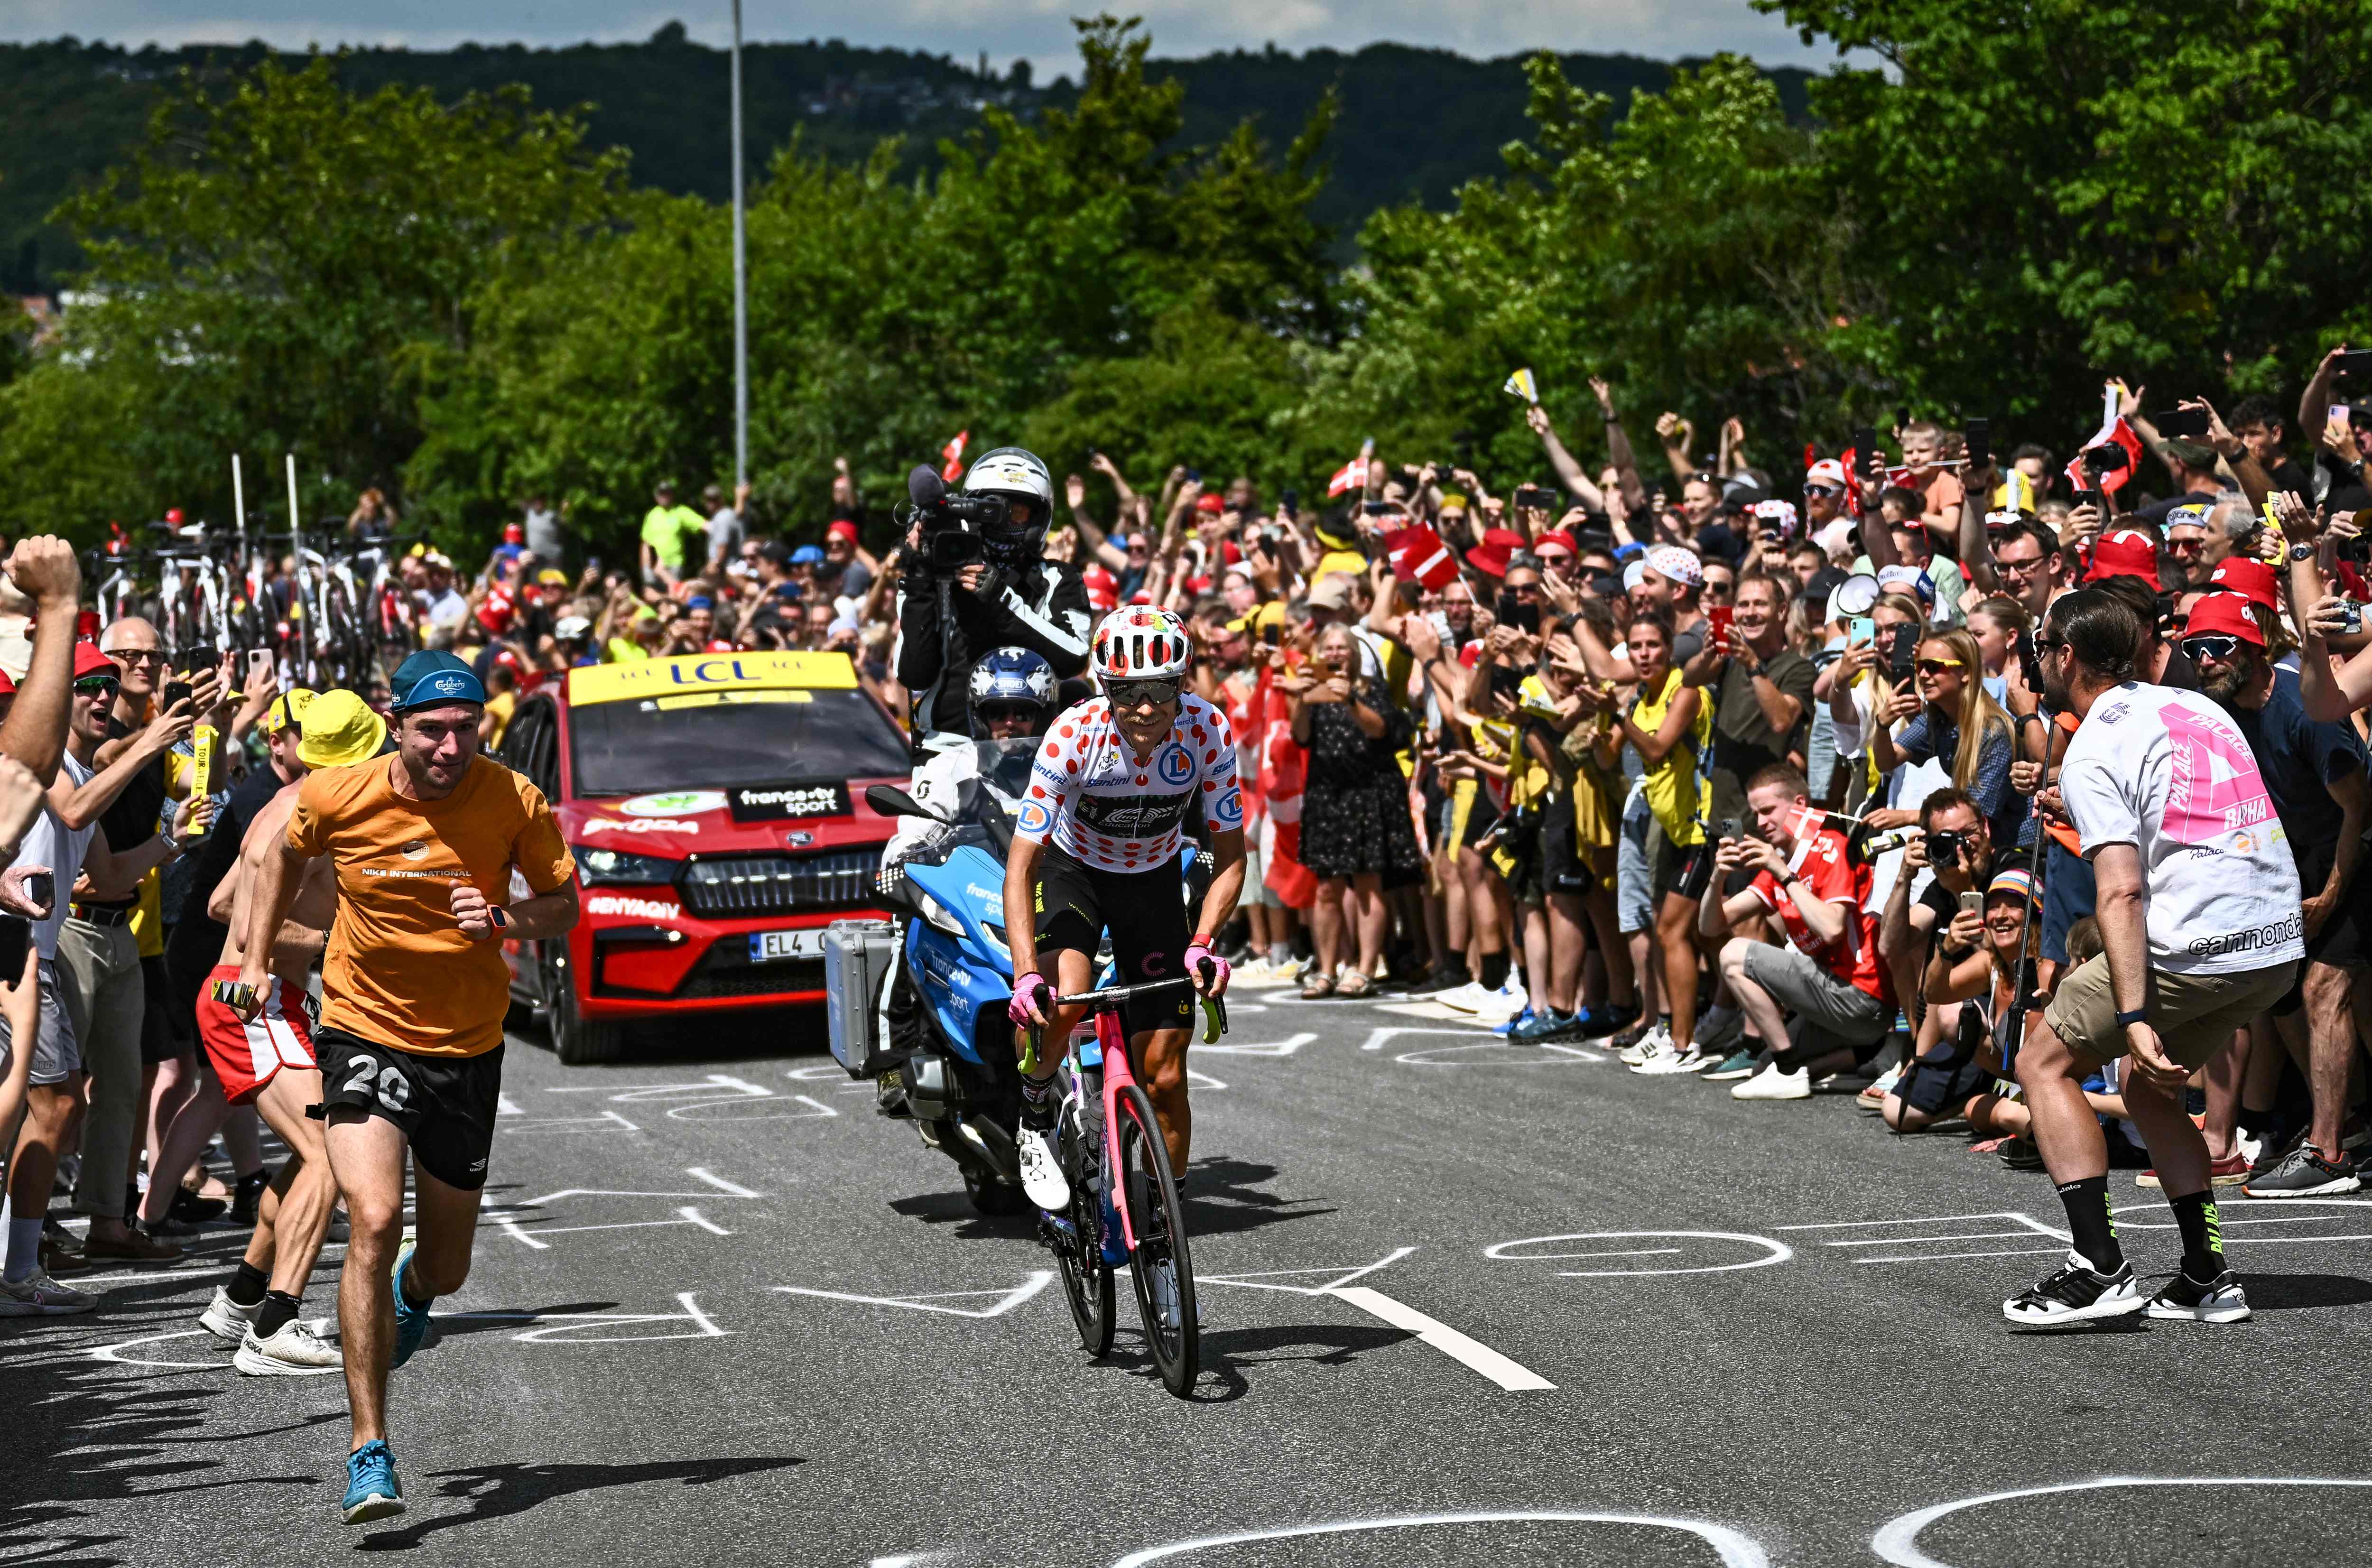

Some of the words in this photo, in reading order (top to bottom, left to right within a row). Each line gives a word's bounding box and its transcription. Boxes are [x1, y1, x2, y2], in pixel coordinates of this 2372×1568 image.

[670, 660, 762, 684] LCL
[435, 679, 465, 691] Carlsberg
[998, 679, 1023, 688] SHOEI
[2186, 714, 2253, 761] PALACE
[1084, 775, 1131, 788] Santini
[2169, 738, 2192, 813] PALACE
[786, 798, 839, 816] sport
[2224, 798, 2267, 830] RAPHA
[362, 868, 386, 877] NIKE
[389, 870, 472, 878] INTERNATIONAL
[966, 882, 1003, 902] france
[984, 903, 1003, 915] spo
[2188, 910, 2302, 956] cannonda
[948, 990, 970, 1014] sport
[343, 1054, 409, 1111] 20
[2232, 1294, 2244, 1302] Y-3
[244, 1338, 262, 1355] HOKA
